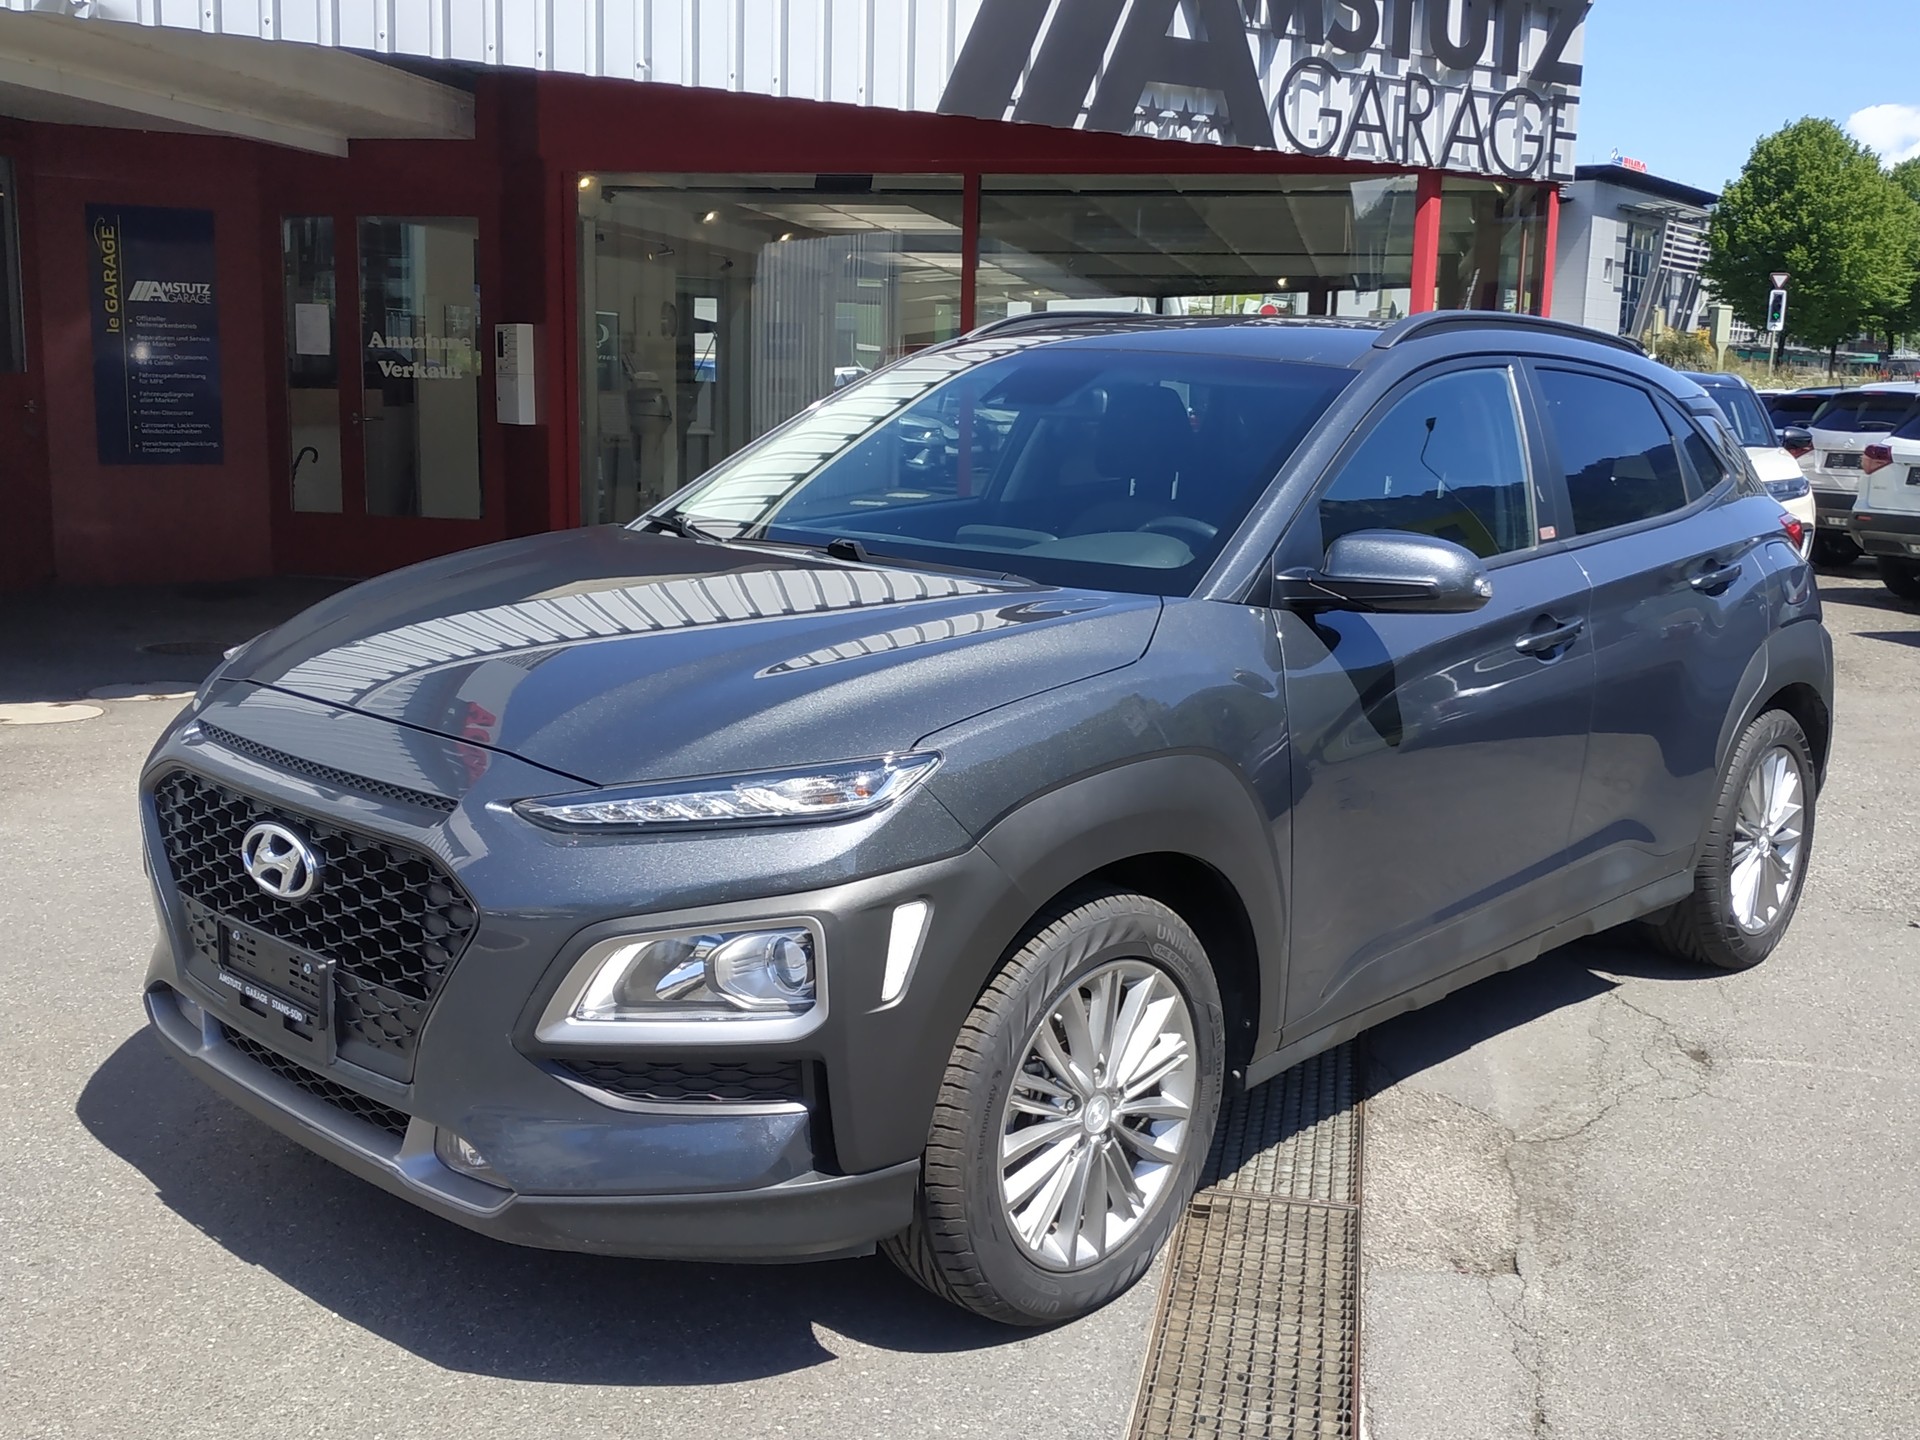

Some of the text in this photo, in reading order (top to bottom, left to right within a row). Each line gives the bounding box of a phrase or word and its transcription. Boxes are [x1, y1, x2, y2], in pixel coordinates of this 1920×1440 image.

[1278, 56, 1580, 181] GARAGE
[102, 226, 119, 333] le GARAGE
[147, 281, 211, 302] AMSTUTZ
[165, 292, 211, 304] GARAGE
[136, 321, 198, 330] Mehrmarkenbetrieb
[367, 331, 472, 349] Annahme
[377, 360, 463, 379] Verkauf
[218, 972, 242, 992] AMSTUTZ
[244, 986, 268, 1004] GARAGE
